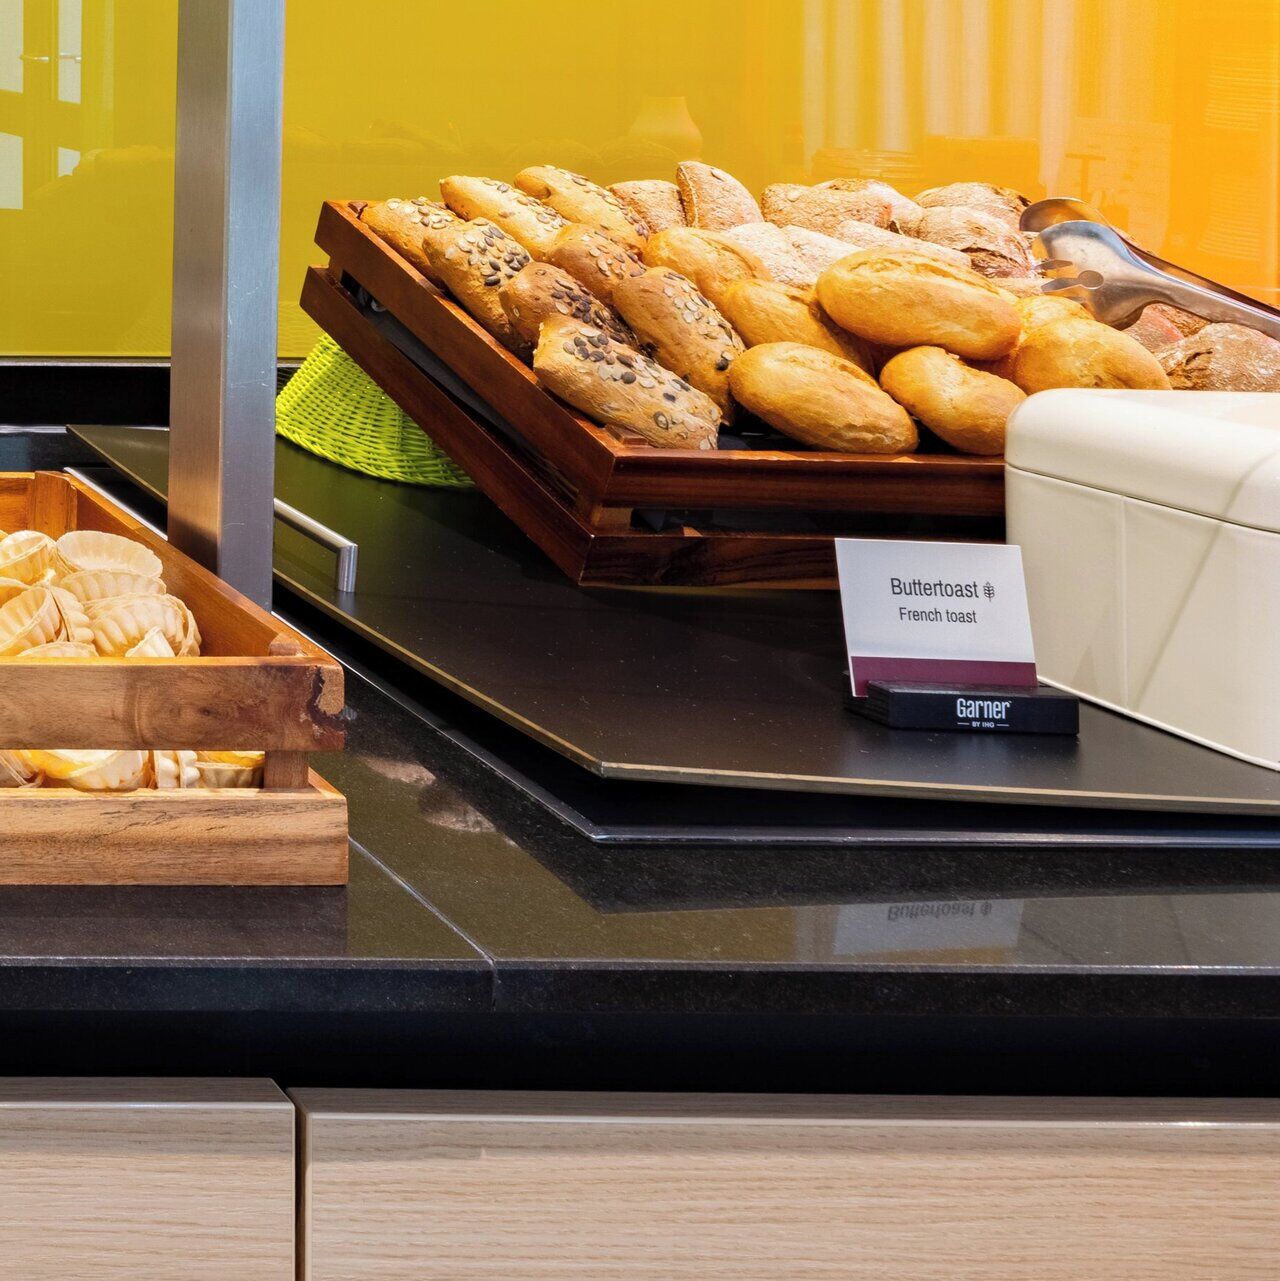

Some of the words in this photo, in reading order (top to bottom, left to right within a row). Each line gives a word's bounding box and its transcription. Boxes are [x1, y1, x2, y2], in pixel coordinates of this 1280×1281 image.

[890, 577, 980, 598] Buttertoast
[899, 607, 943, 622] French
[945, 609, 978, 624] toast
[956, 698, 1011, 719] Garner
